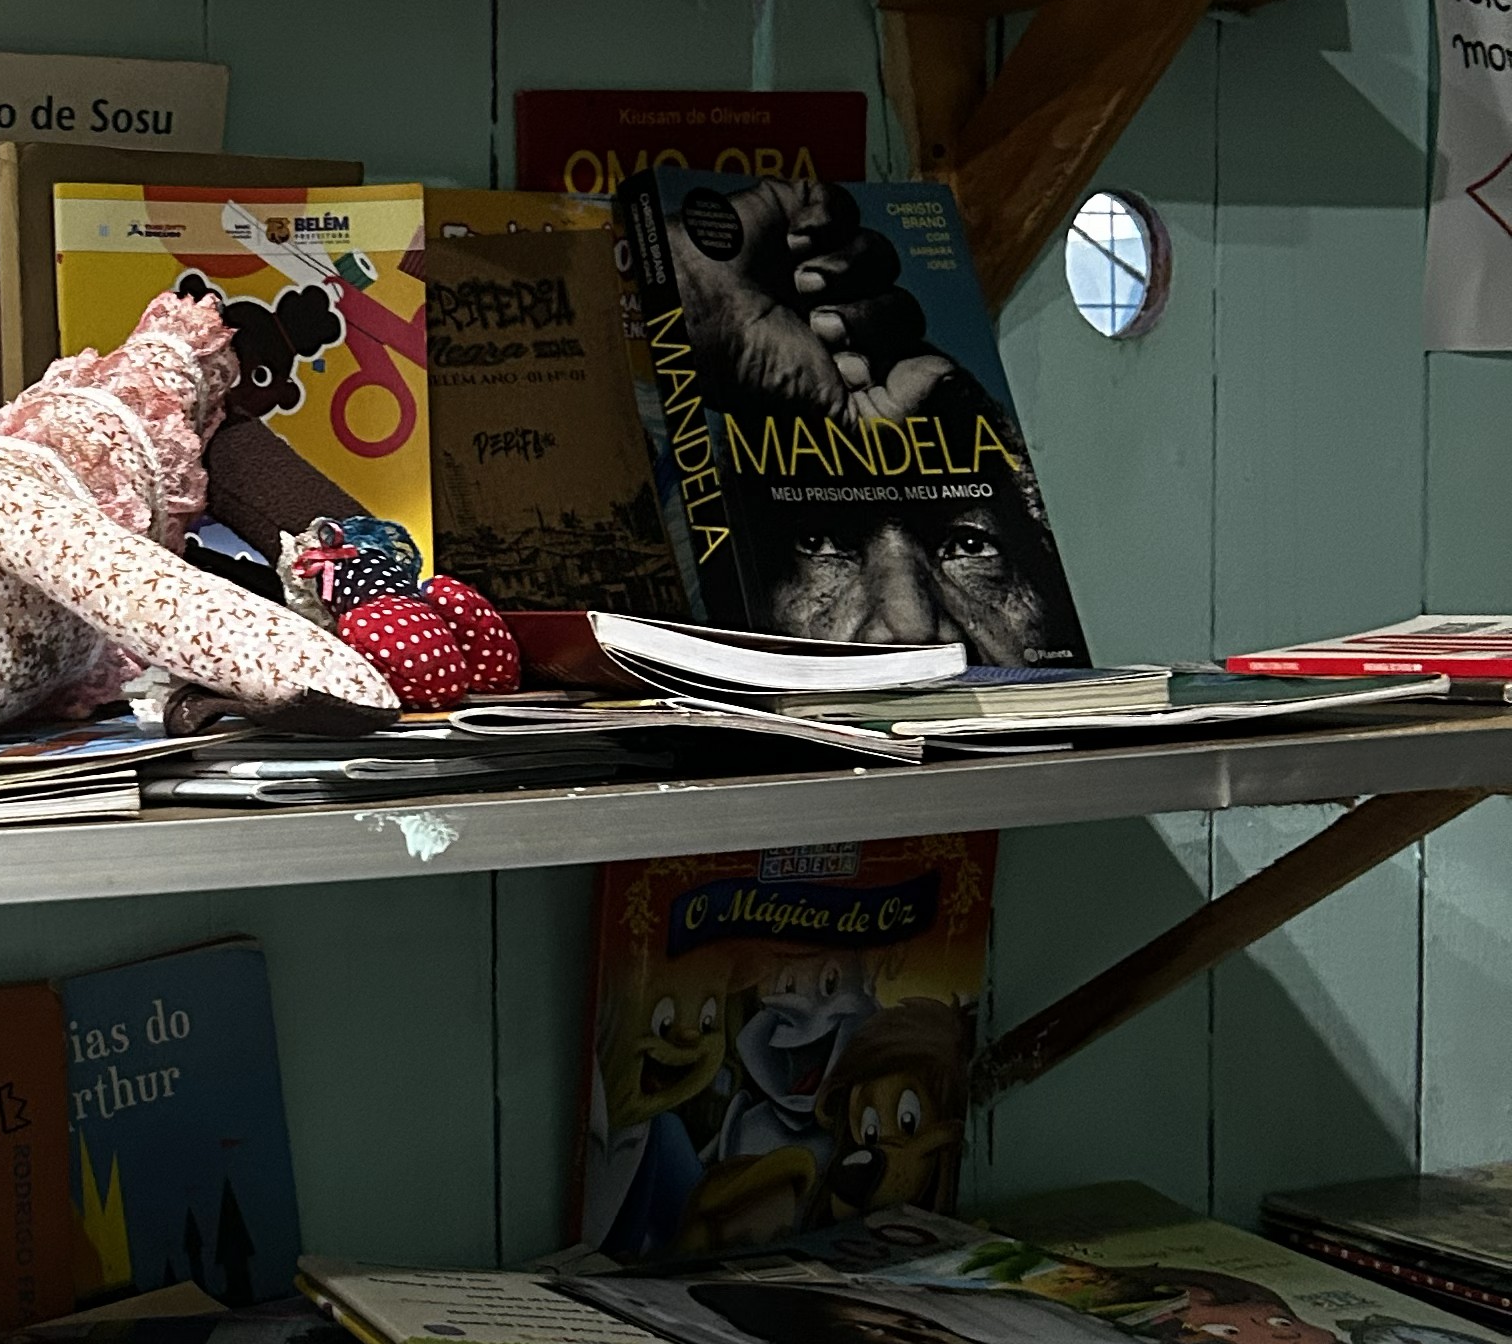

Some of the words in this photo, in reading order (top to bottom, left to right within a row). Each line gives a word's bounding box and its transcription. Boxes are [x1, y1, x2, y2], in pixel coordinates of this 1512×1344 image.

[32, 96, 76, 132] de
[90, 99, 174, 135] Sosu
[710, 107, 771, 126] Oliveira
[294, 212, 350, 233] BELÉM
[888, 202, 944, 217] CHRISTO
[901, 215, 947, 229] BRAND
[481, 372, 519, 385] ANO
[647, 306, 733, 565] MANDELA
[724, 414, 1020, 477] MANDELA
[772, 487, 804, 503] MEU
[805, 486, 902, 504] PRISIONEIRO,
[905, 485, 938, 500] MEU
[941, 483, 993, 498] AMIGO
[685, 894, 709, 931] O
[717, 888, 831, 934] Mágico
[838, 901, 871, 933] de
[877, 896, 918, 932] Oz
[145, 999, 190, 1045] do
[71, 1064, 181, 1126] rthur
